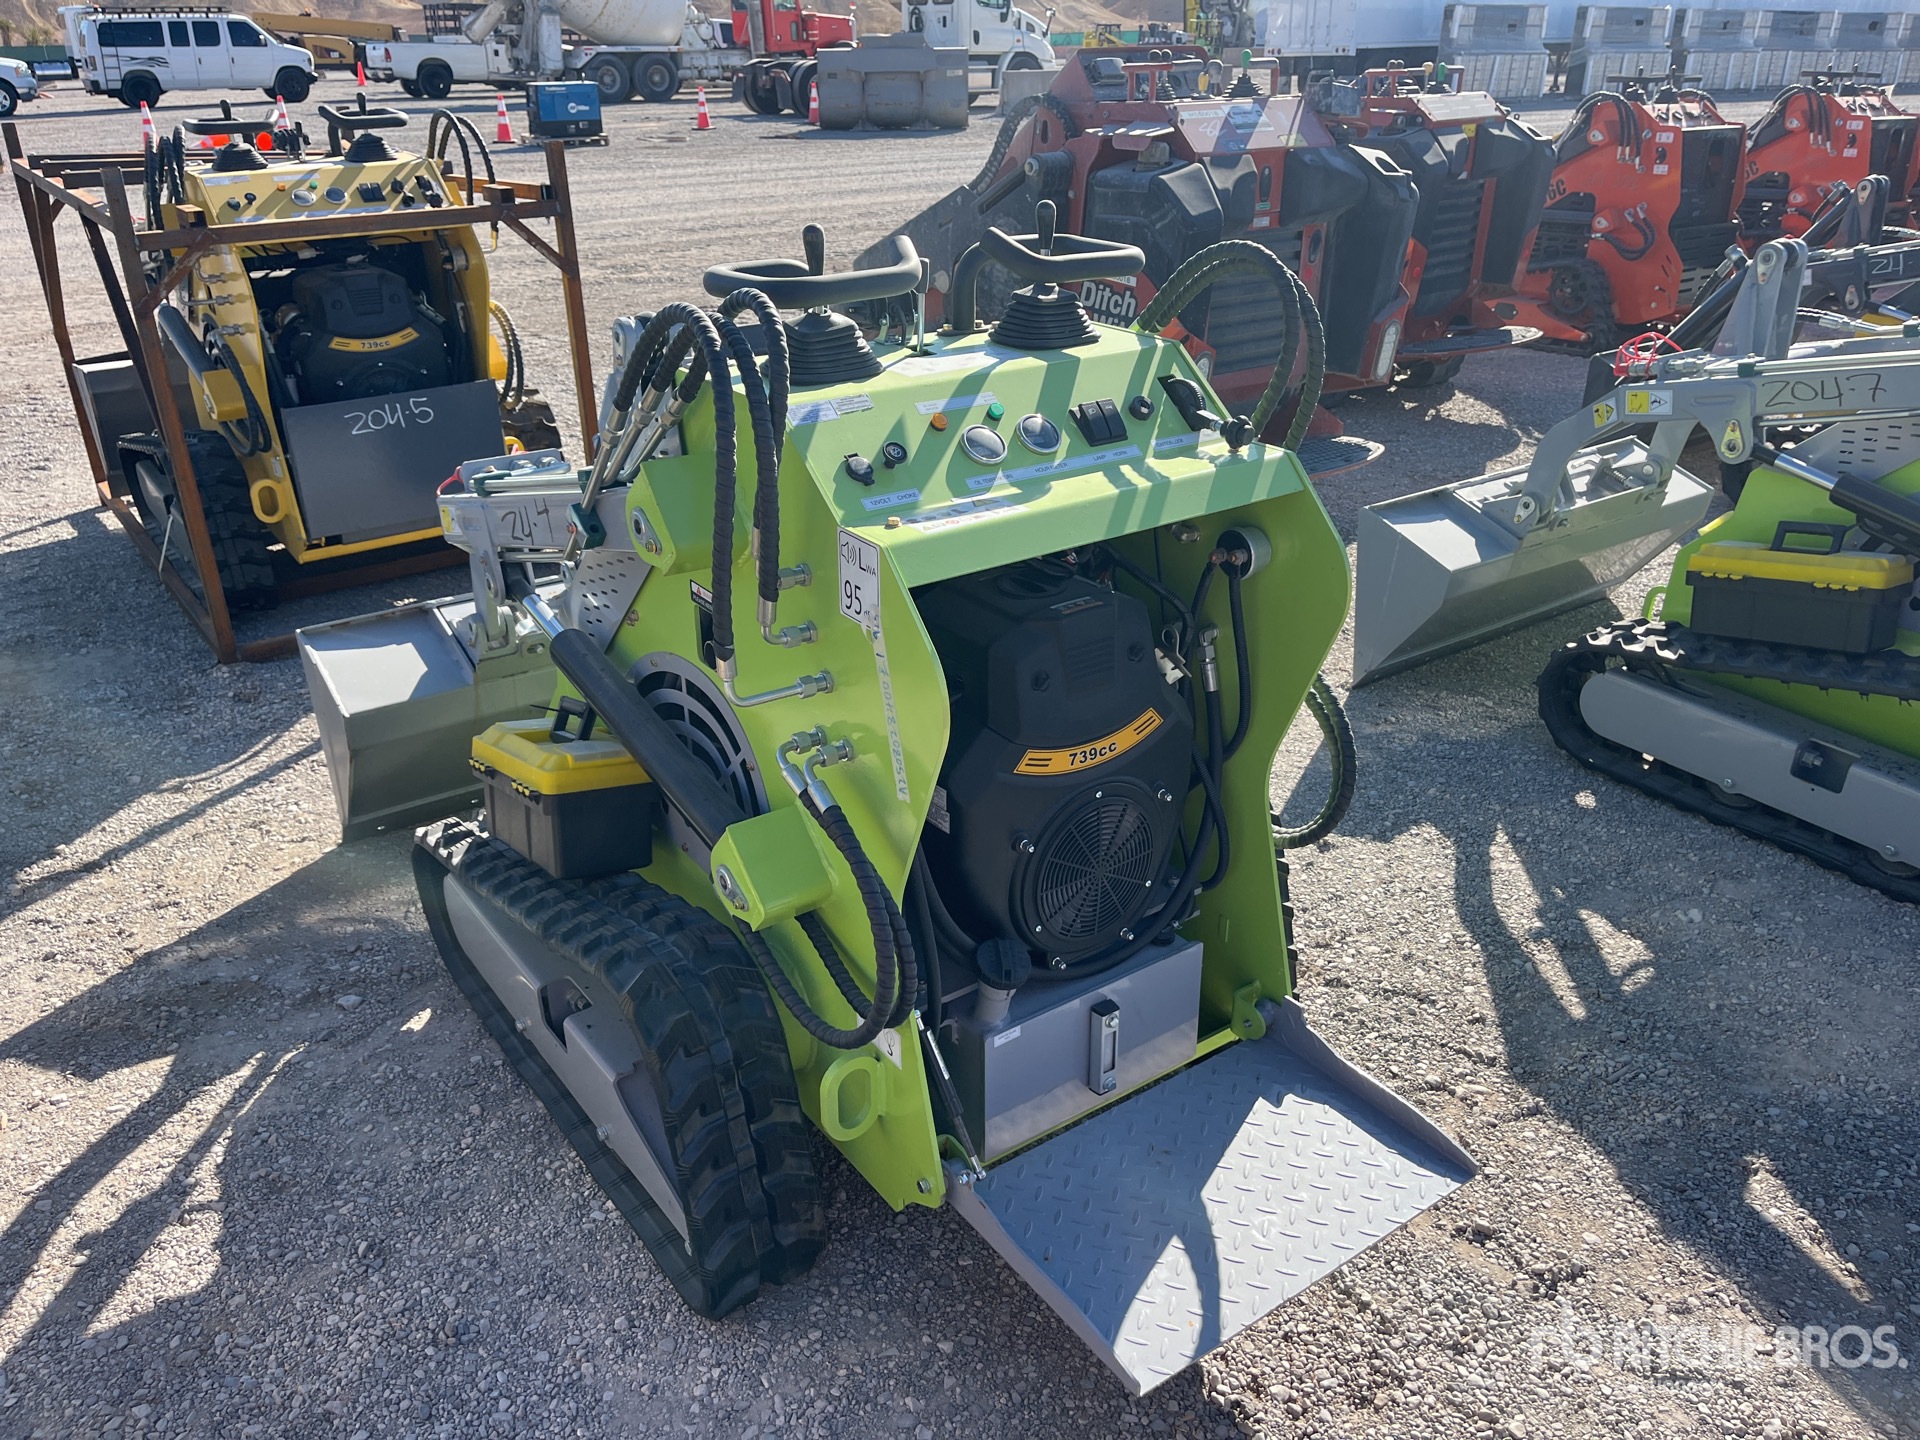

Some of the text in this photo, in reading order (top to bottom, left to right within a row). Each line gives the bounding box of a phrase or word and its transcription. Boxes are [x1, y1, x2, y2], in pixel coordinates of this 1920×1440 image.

[1080, 281, 1136, 318] Ditch
[360, 340, 390, 349] 739cc
[1035, 465, 1050, 473] HOUR
[1093, 454, 1107, 462] LAMP
[870, 492, 917, 506] 12VOLT CHOKE
[844, 579, 863, 616] 95
[1068, 741, 1117, 766] 739cc
